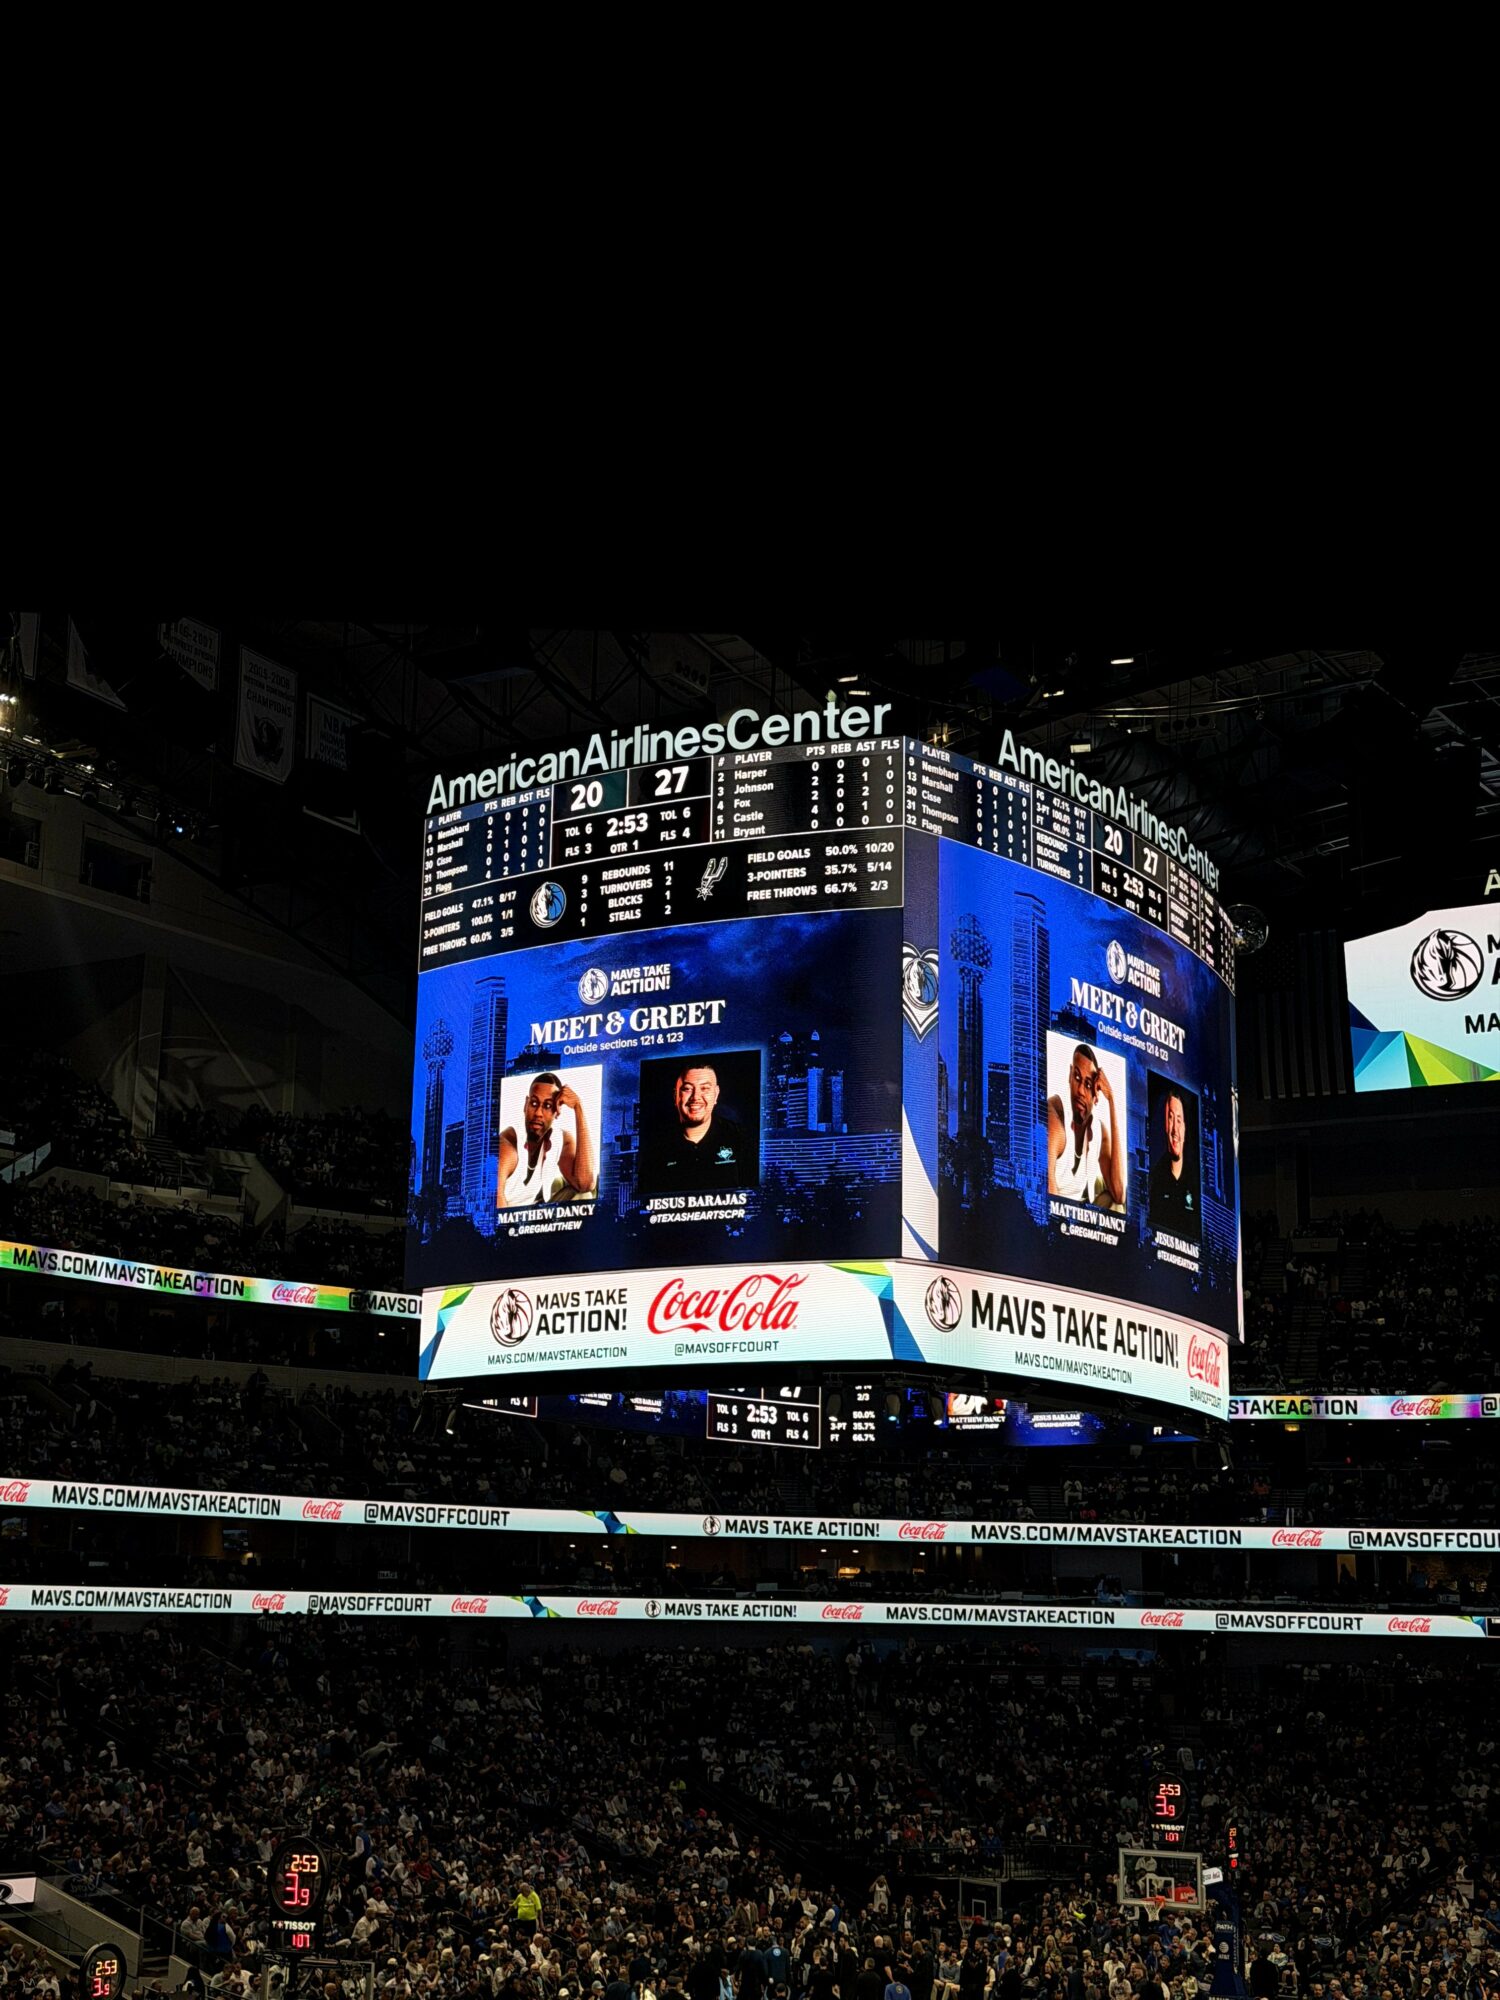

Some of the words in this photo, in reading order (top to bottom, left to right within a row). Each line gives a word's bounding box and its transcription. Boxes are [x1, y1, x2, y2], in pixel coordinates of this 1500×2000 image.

[734, 751, 772, 764] PLAYER
[806, 746, 826, 757] PTS
[830, 743, 852, 754] REB
[856, 741, 876, 752] AST
[881, 739, 900, 750] FLS
[655, 766, 689, 796] 27
[718, 772, 724, 782] 2
[734, 768, 768, 781] Harper
[570, 781, 603, 811] 20
[718, 786, 724, 796] 3
[734, 782, 774, 794] Johnson
[660, 810, 678, 822] TOL
[682, 807, 691, 818] 6
[716, 801, 724, 810] 4
[734, 798, 751, 808] Fox
[606, 812, 648, 838] 2:53
[716, 815, 724, 825] 5
[734, 811, 764, 823] Castle
[565, 826, 580, 838] TOL
[585, 823, 592, 835] 6
[660, 830, 676, 842] FLS
[682, 827, 691, 839] 4
[714, 829, 725, 840] 11
[734, 825, 766, 838] Bryant
[1104, 824, 1122, 856] 20
[565, 846, 580, 858] FLS
[584, 843, 592, 855] 3
[632, 840, 639, 850] 1
[748, 852, 775, 864] FIELD
[777, 848, 811, 861] GOALS
[825, 844, 858, 856] 50.0%
[865, 842, 894, 854] 10/20
[582, 874, 588, 884] 9
[602, 864, 651, 881] REBOUNDS
[664, 861, 674, 872] 11
[747, 867, 807, 882] 3-POINTERS
[824, 864, 858, 876] 35.7%
[867, 861, 892, 872] 5/14
[1143, 847, 1159, 876] 27
[581, 889, 588, 898] 3
[600, 878, 653, 896] TURNOVERS
[665, 876, 672, 886] 2
[747, 889, 772, 901] FREE
[773, 885, 818, 898] THROWS
[824, 882, 858, 894] 66.7%
[870, 880, 888, 891] 2/3
[1123, 873, 1144, 899] 2:53
[424, 908, 442, 922] FIELD
[442, 902, 464, 916] GOALS
[472, 896, 494, 910] 47.1%
[580, 903, 588, 913] 0
[608, 894, 643, 908] BLOCKS
[664, 890, 671, 900] 1
[424, 921, 460, 940] 3-POINTERS
[471, 914, 493, 926] 100.0%
[501, 908, 514, 920] 1/1
[580, 918, 586, 926] 1
[609, 909, 642, 922] STEALS
[664, 905, 672, 914] 2
[422, 943, 438, 956] FREE
[439, 936, 468, 951] THROWS
[470, 932, 492, 944] 60.0%
[500, 926, 514, 938] 3/5
[610, 968, 641, 982] MAVS
[642, 964, 670, 977] TAKE
[1127, 968, 1160, 998] ACTION!
[610, 976, 670, 997] ACTION!
[530, 1014, 604, 1046] MEET
[605, 1010, 625, 1036] &
[630, 1000, 726, 1032] GREET
[1070, 978, 1125, 1025] MEET
[1126, 1000, 1138, 1029] &
[1140, 1008, 1186, 1054] GREET
[564, 1042, 598, 1056] Outside
[600, 1038, 638, 1051] sections
[640, 1034, 655, 1046] 121
[656, 1034, 665, 1044] &
[666, 1032, 684, 1043] 123
[1098, 1021, 1122, 1040] Outside
[1122, 1031, 1146, 1051] sections
[646, 1196, 686, 1211] JESUS
[688, 1192, 747, 1208] BARAJAS
[498, 1207, 554, 1224] MATTHEW
[556, 1204, 596, 1220] DANCY
[650, 1209, 746, 1224] @TEXASHEARTSCPR
[1050, 1200, 1098, 1226] MATTHEW
[1099, 1212, 1126, 1234] DANCY
[12, 1247, 245, 1298] MAVS.COM/MAVSTAKEACTION
[536, 1292, 581, 1310] MAVS
[584, 1288, 628, 1306] TAKE
[536, 1308, 628, 1337] ACTION!
[971, 1290, 1046, 1340] MAVS
[1052, 1304, 1108, 1352] TAKE
[1113, 1318, 1180, 1370] ACTION!
[487, 1346, 628, 1366] MAVS.COM/MAVSTAKEACTION
[674, 1340, 780, 1357] @MAVSOFFCOURT
[1014, 1350, 1132, 1385] MAVS.COM/MAVSTAKEACTION
[747, 1404, 778, 1425] 2:53
[52, 1485, 281, 1516] MAVS.COM/MAVSTAKEACTION
[364, 1503, 510, 1527] @MAVSOFFCOURT
[724, 1519, 768, 1534] MAVS
[773, 1520, 813, 1536] TAKE
[817, 1522, 880, 1538] ACTION!
[971, 1524, 1242, 1545] MAVS.COM/MAVSTAKEACTION
[31, 1589, 232, 1609] MAVS.COM/MAVSTAKEACTION
[308, 1595, 432, 1612] @MAVSOFFCOURT
[664, 1602, 702, 1616] MAVS
[705, 1602, 740, 1618] TAKE
[742, 1604, 798, 1618] ACTION!
[886, 1606, 1115, 1625] MAVS.COM/MAVSTAKEACTION
[1216, 1612, 1364, 1632] @MAVSOFFCOURT
[1159, 1784, 1182, 1796] 2:53
[1160, 1824, 1185, 1832] TISSOT
[290, 1854, 320, 1873] 2:53
[284, 1920, 317, 1932] TISSOT
[95, 1960, 118, 1976] 2:53
